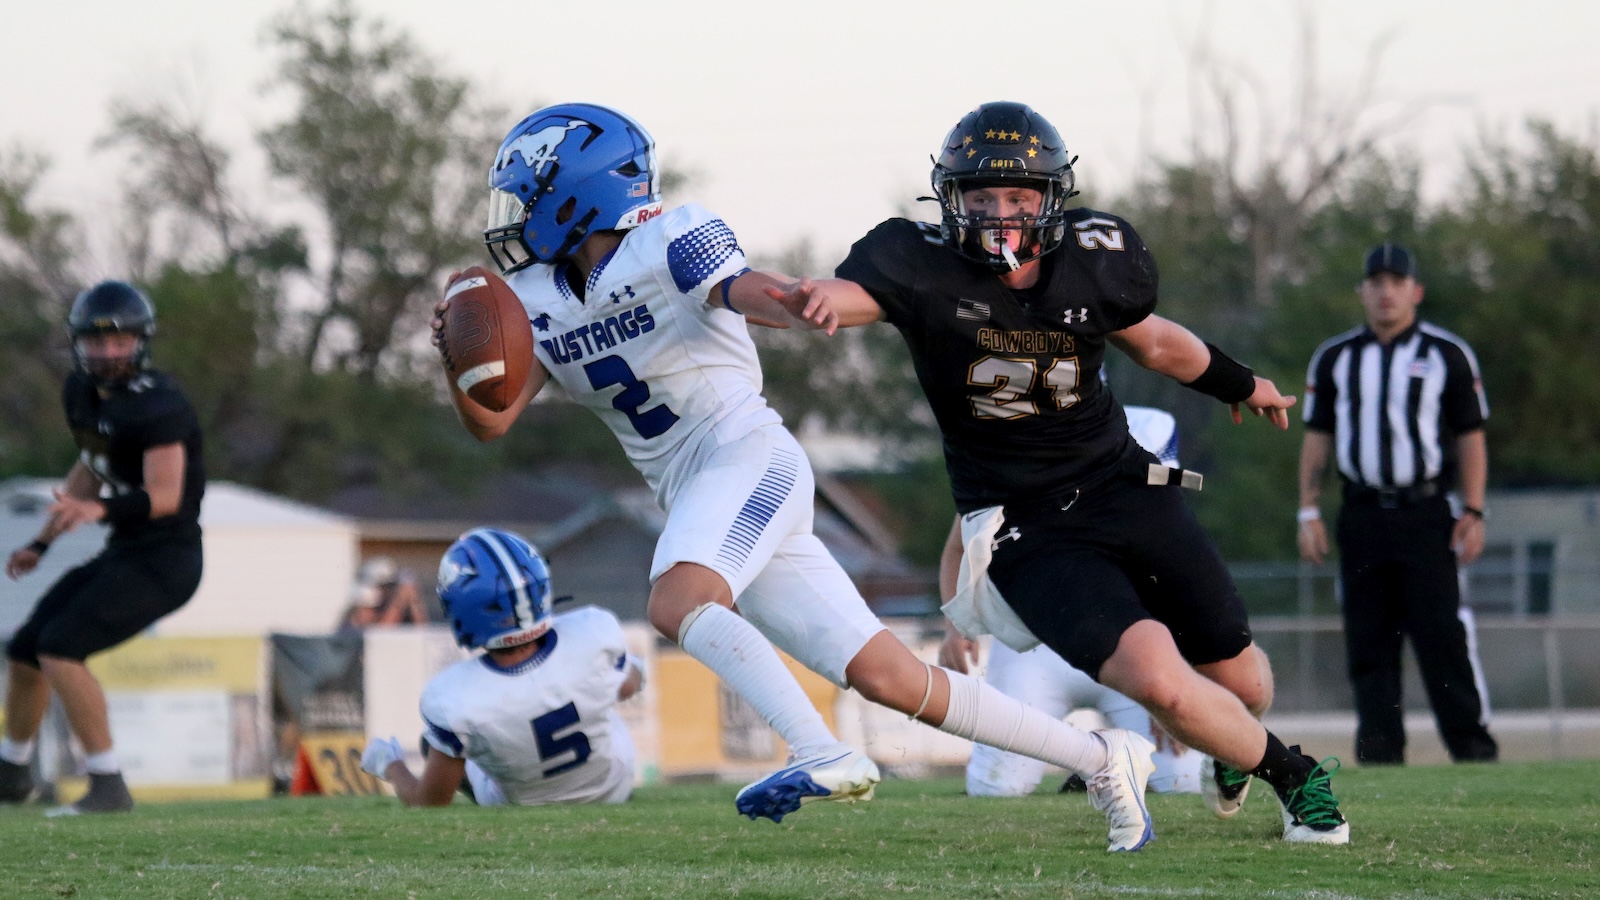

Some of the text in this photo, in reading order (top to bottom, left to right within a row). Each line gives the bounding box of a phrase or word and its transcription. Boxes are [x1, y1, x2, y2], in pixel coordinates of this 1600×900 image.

[990, 159, 1014, 168] GRIT
[1072, 217, 1125, 251] 21
[540, 304, 655, 365] MUSTANGS
[977, 328, 1075, 353] COWBOYS
[582, 354, 680, 440] 2
[967, 355, 1081, 420] 21
[530, 701, 591, 778] 5
